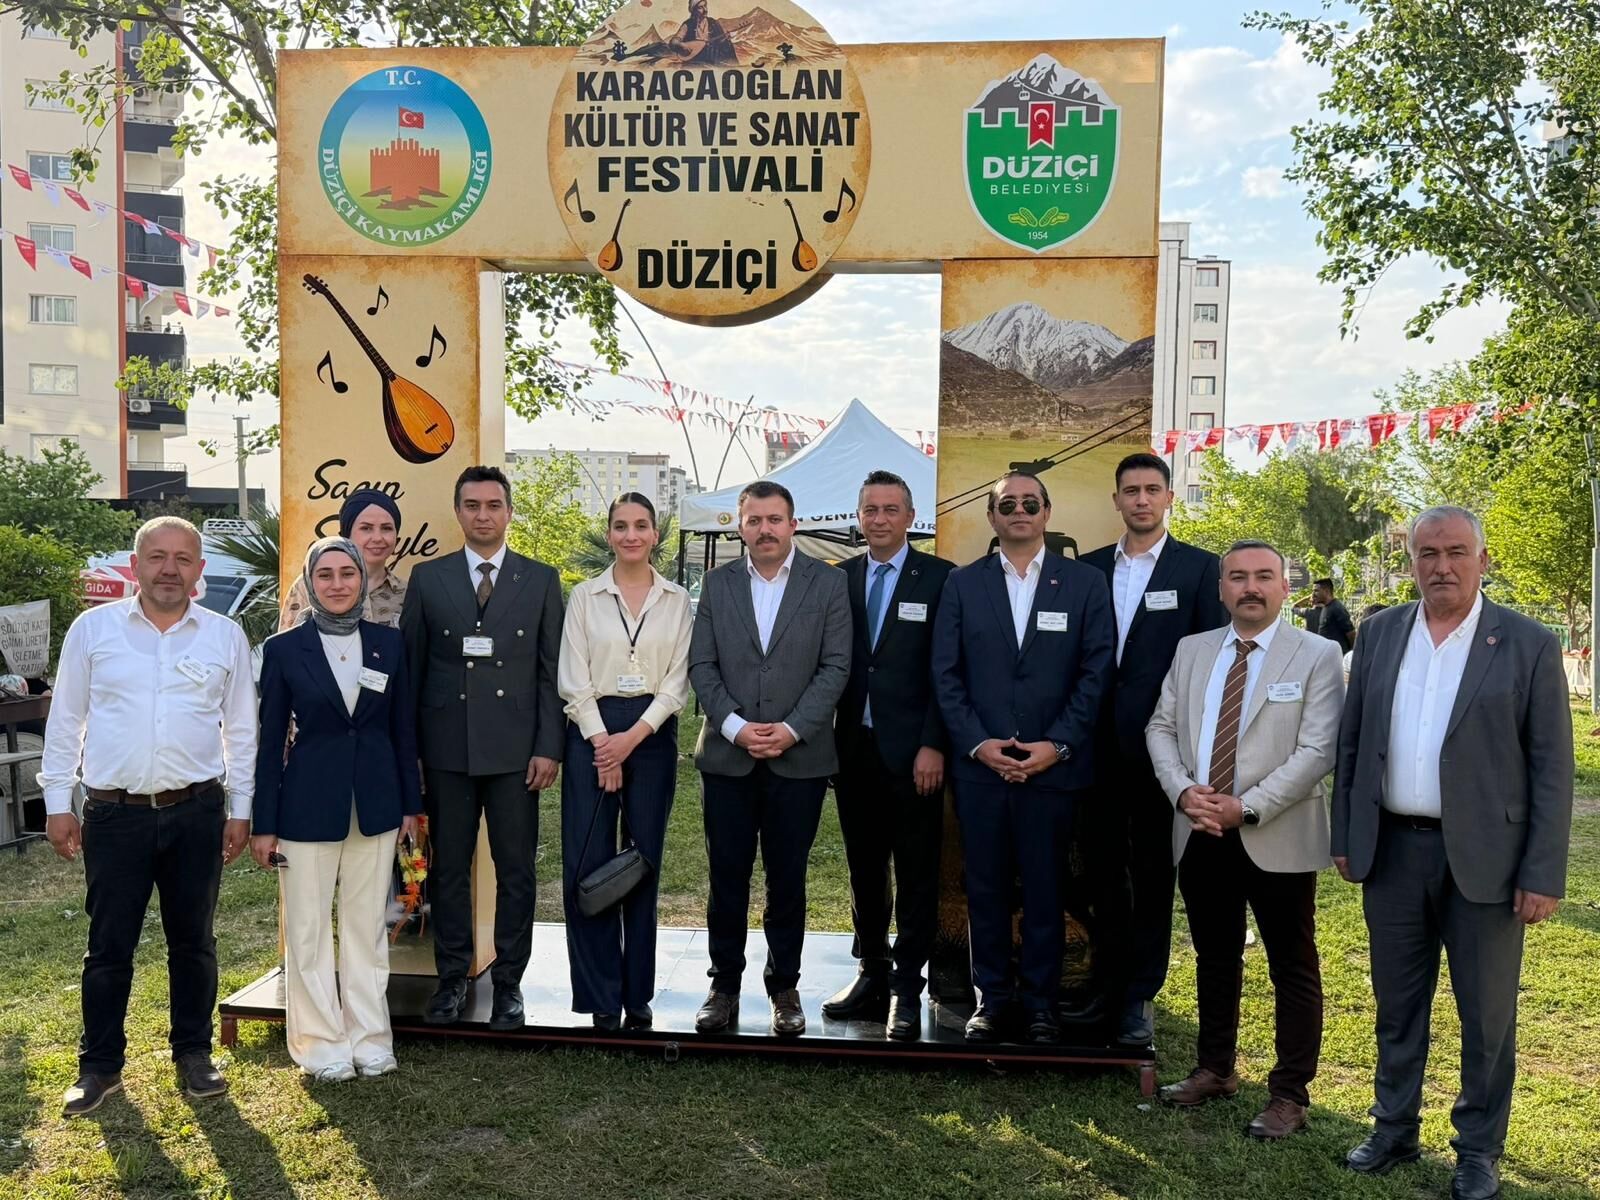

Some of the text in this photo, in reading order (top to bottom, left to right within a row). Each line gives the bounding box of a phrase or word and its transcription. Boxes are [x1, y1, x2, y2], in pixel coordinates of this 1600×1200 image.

[385, 70, 421, 85] T.C.
[576, 63, 842, 101] KARACAOĞLAN
[564, 105, 860, 147] KÜLTÜR VE SANAT
[598, 148, 823, 193] FESTİVALİ
[982, 154, 1098, 180] DÜZİÇİ
[322, 148, 488, 242] DÜZİÇİ KAYMAKAMLIĞI
[990, 183, 1089, 195] BELEDİYESİ
[1027, 231, 1048, 240] 1954
[637, 240, 777, 295] DÜZİÇİ
[307, 459, 405, 500] San
[85, 583, 112, 594] GIDA
